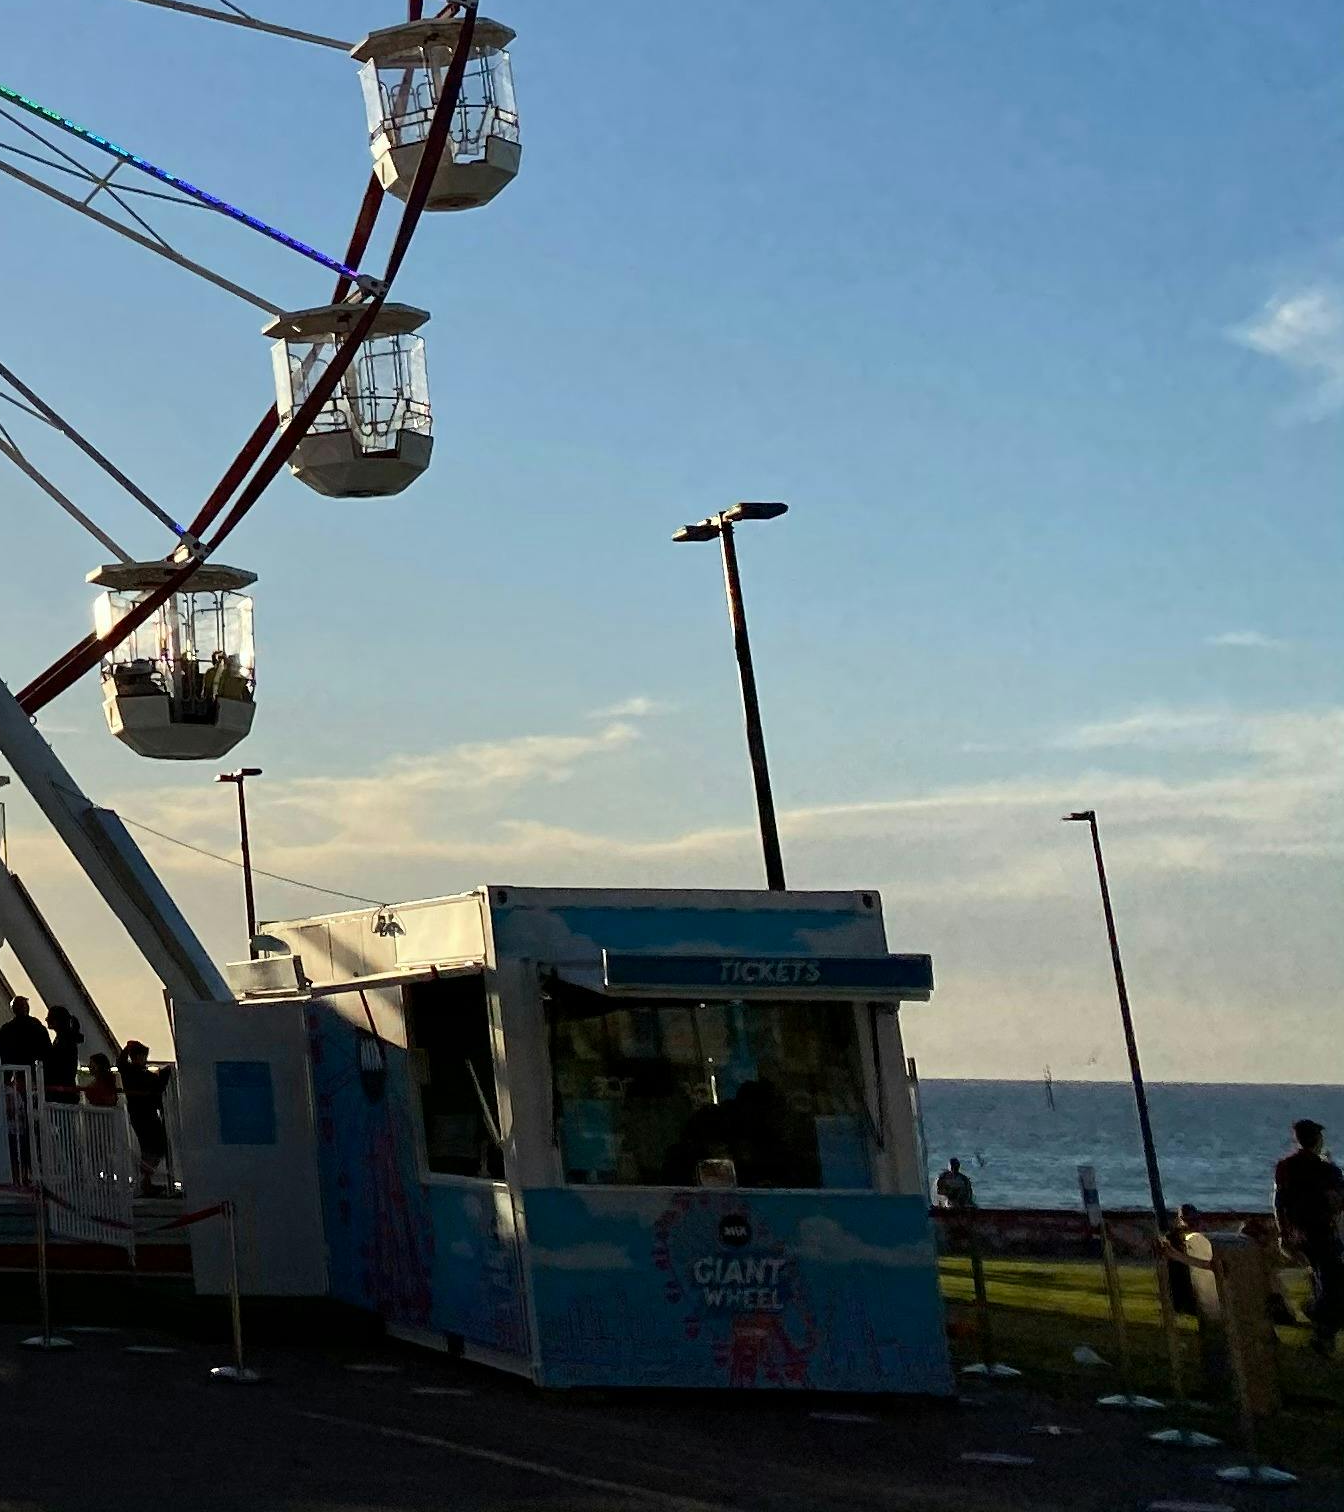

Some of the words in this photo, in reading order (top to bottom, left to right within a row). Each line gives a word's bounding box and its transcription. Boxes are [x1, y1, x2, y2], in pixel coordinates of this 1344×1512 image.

[720, 960, 822, 983] TICKETS
[693, 1256, 786, 1285] GIANT
[703, 1287, 785, 1310] WHEEL
